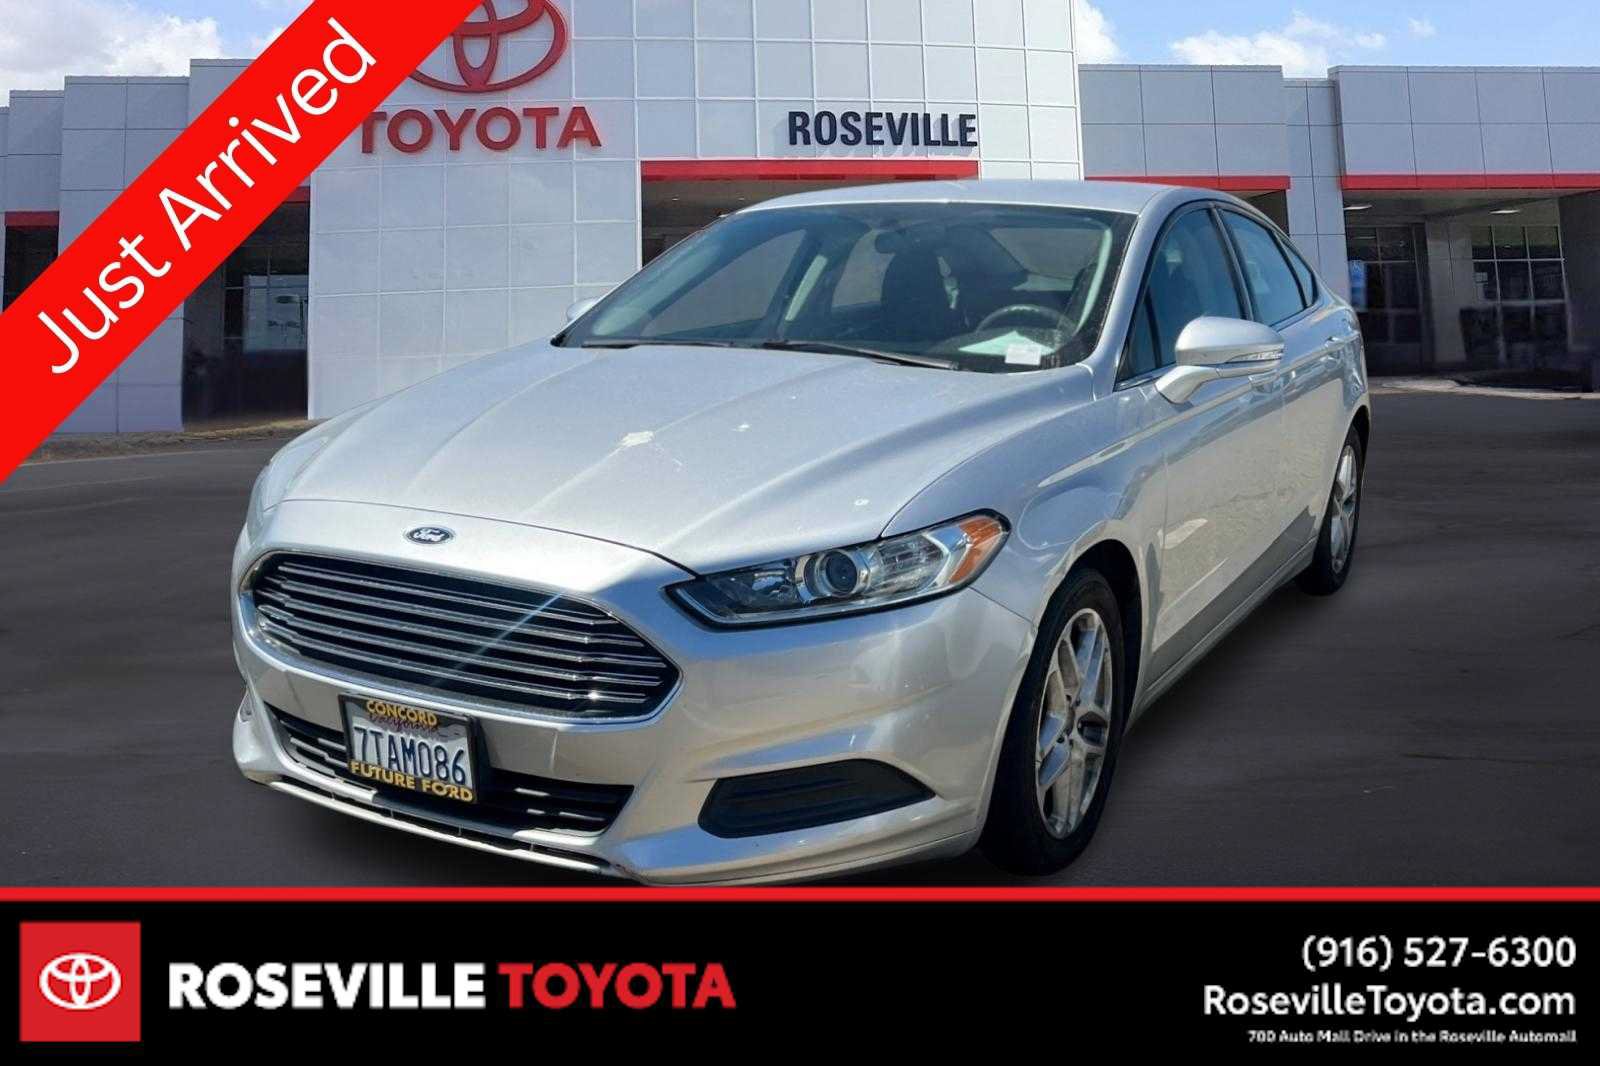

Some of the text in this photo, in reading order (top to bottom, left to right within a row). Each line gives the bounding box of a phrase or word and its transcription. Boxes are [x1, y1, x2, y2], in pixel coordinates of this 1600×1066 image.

[361, 106, 602, 154] TOYOTA
[788, 111, 978, 147] ROSEVILLE
[366, 700, 438, 726] CONCORD
[353, 725, 467, 785] 7TAM086
[350, 761, 474, 802] FUTURE FORD
